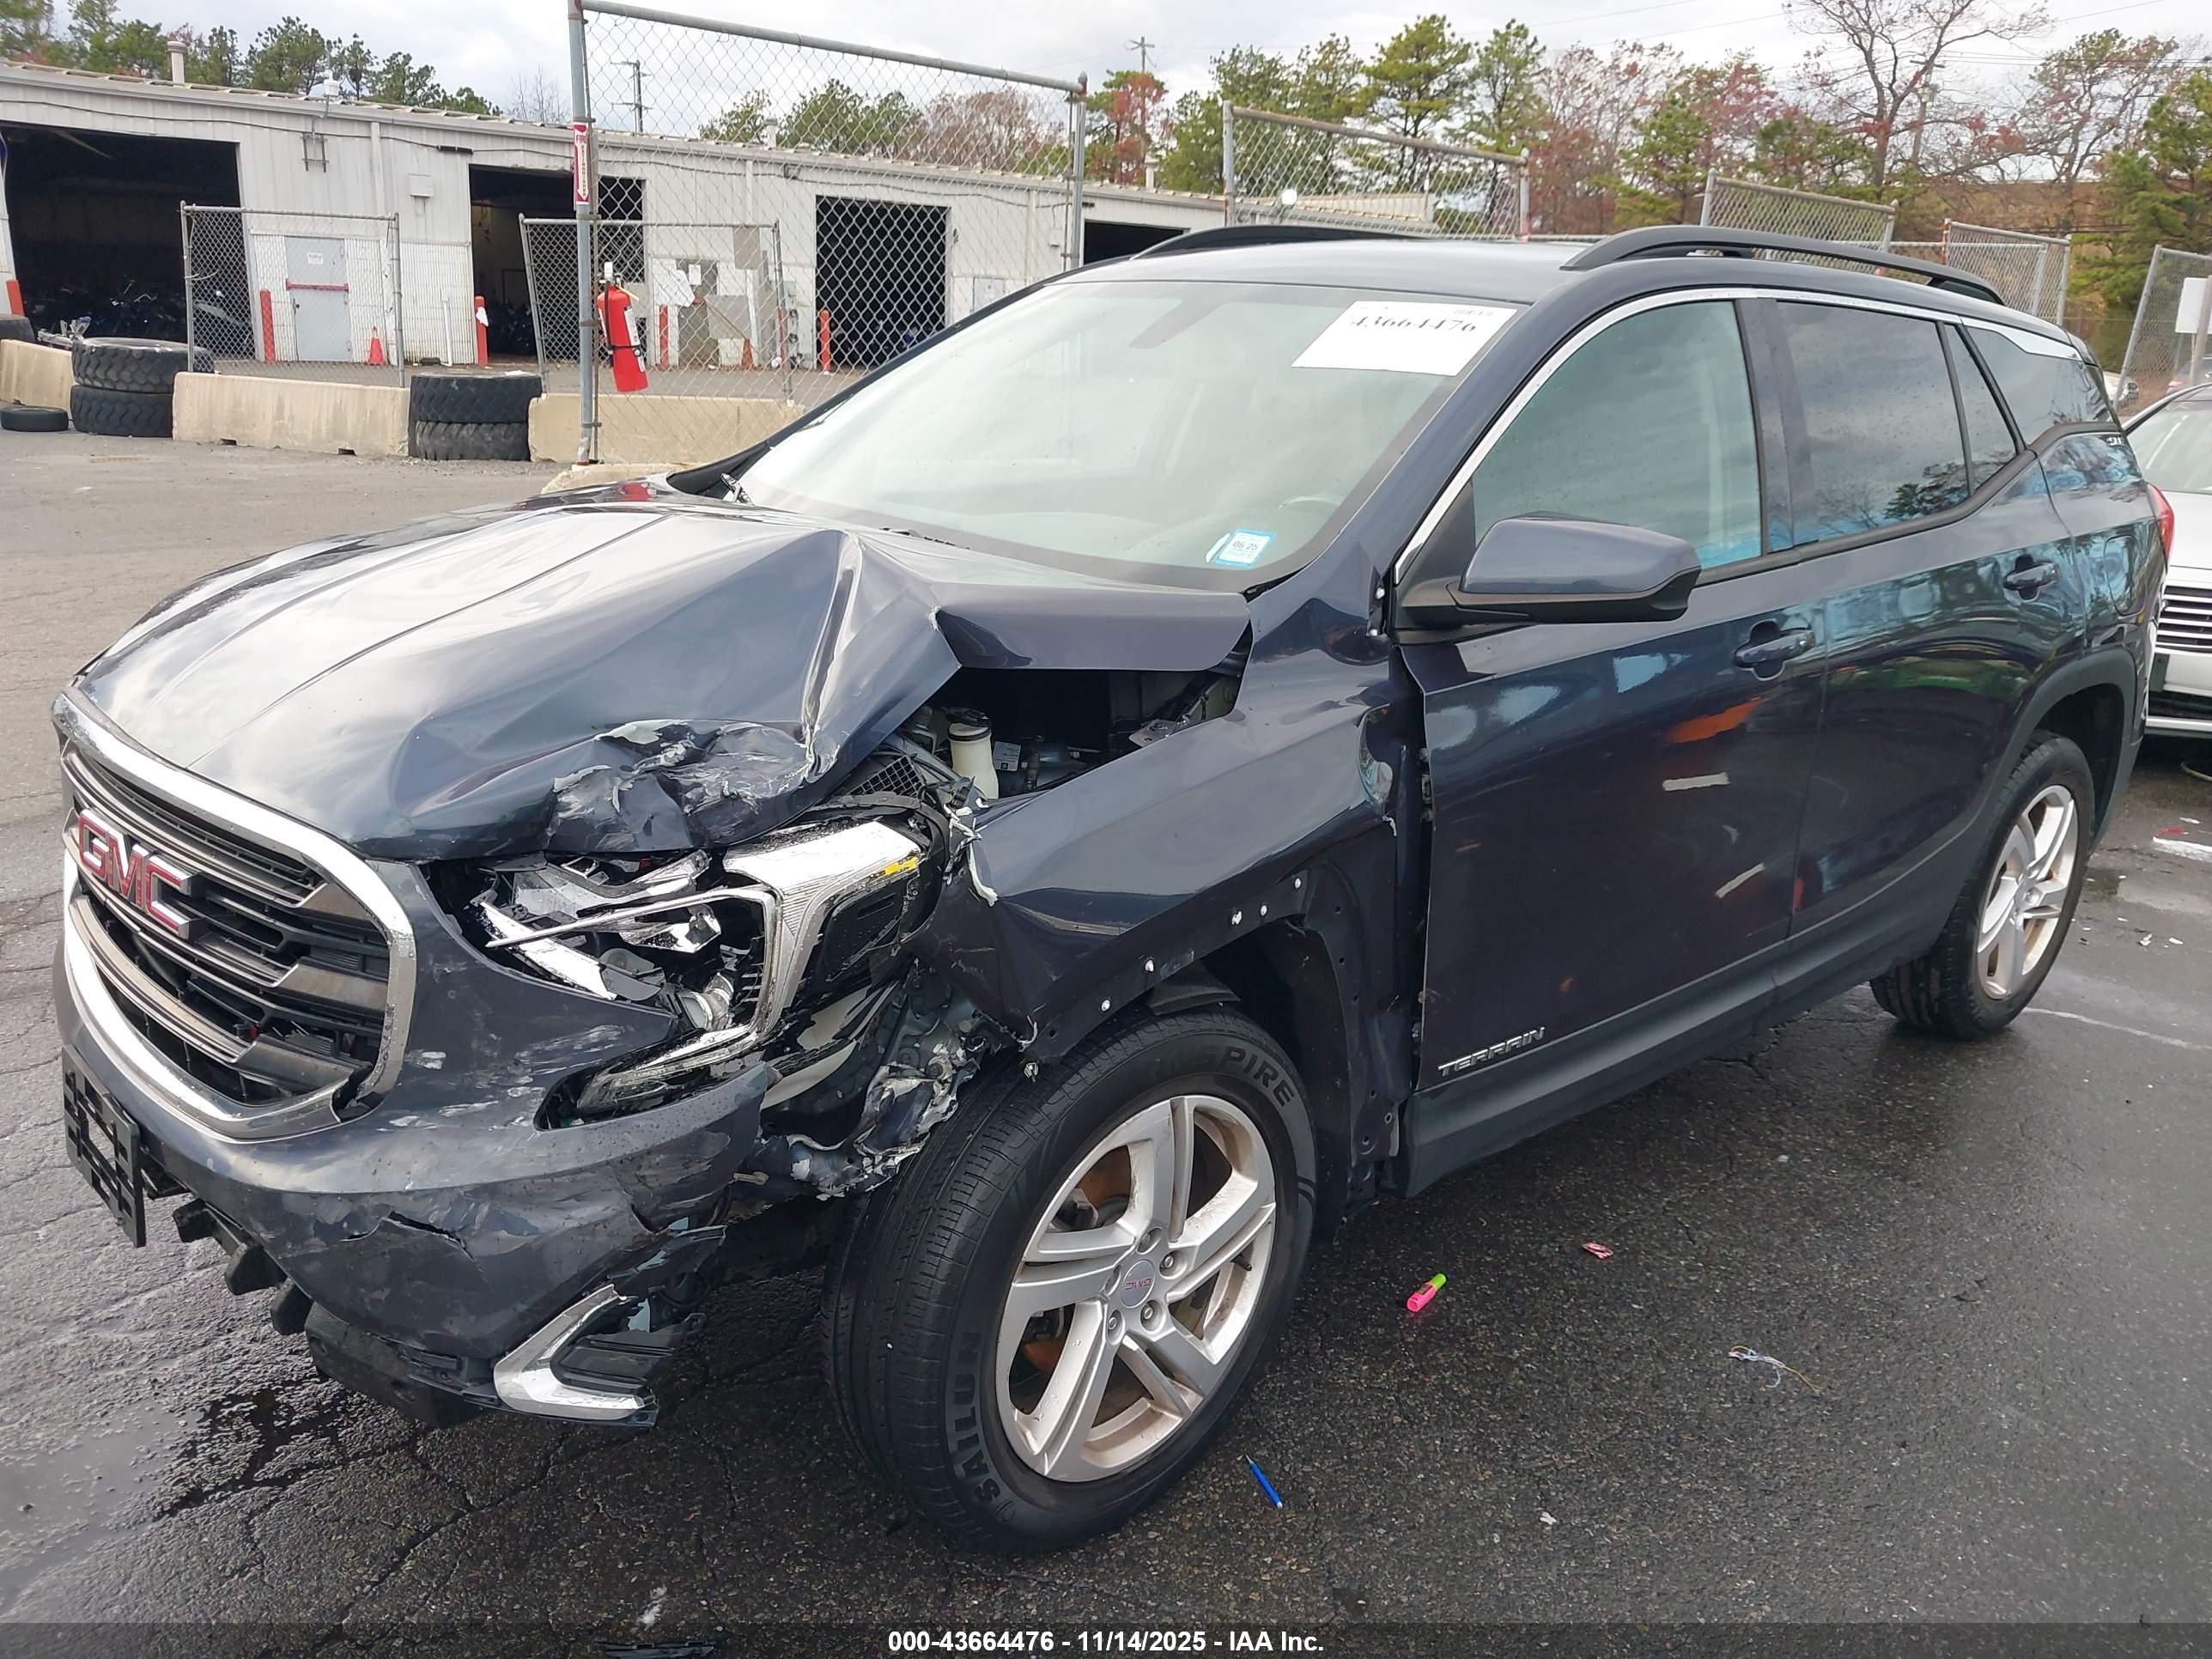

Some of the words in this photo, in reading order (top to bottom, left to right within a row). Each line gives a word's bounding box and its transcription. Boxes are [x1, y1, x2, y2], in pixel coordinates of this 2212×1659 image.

[576, 134, 587, 144] FIRE
[79, 809, 190, 939] GMC
[1437, 1026, 1546, 1077] TERRAIN
[1124, 1277, 1153, 1291] GMC
